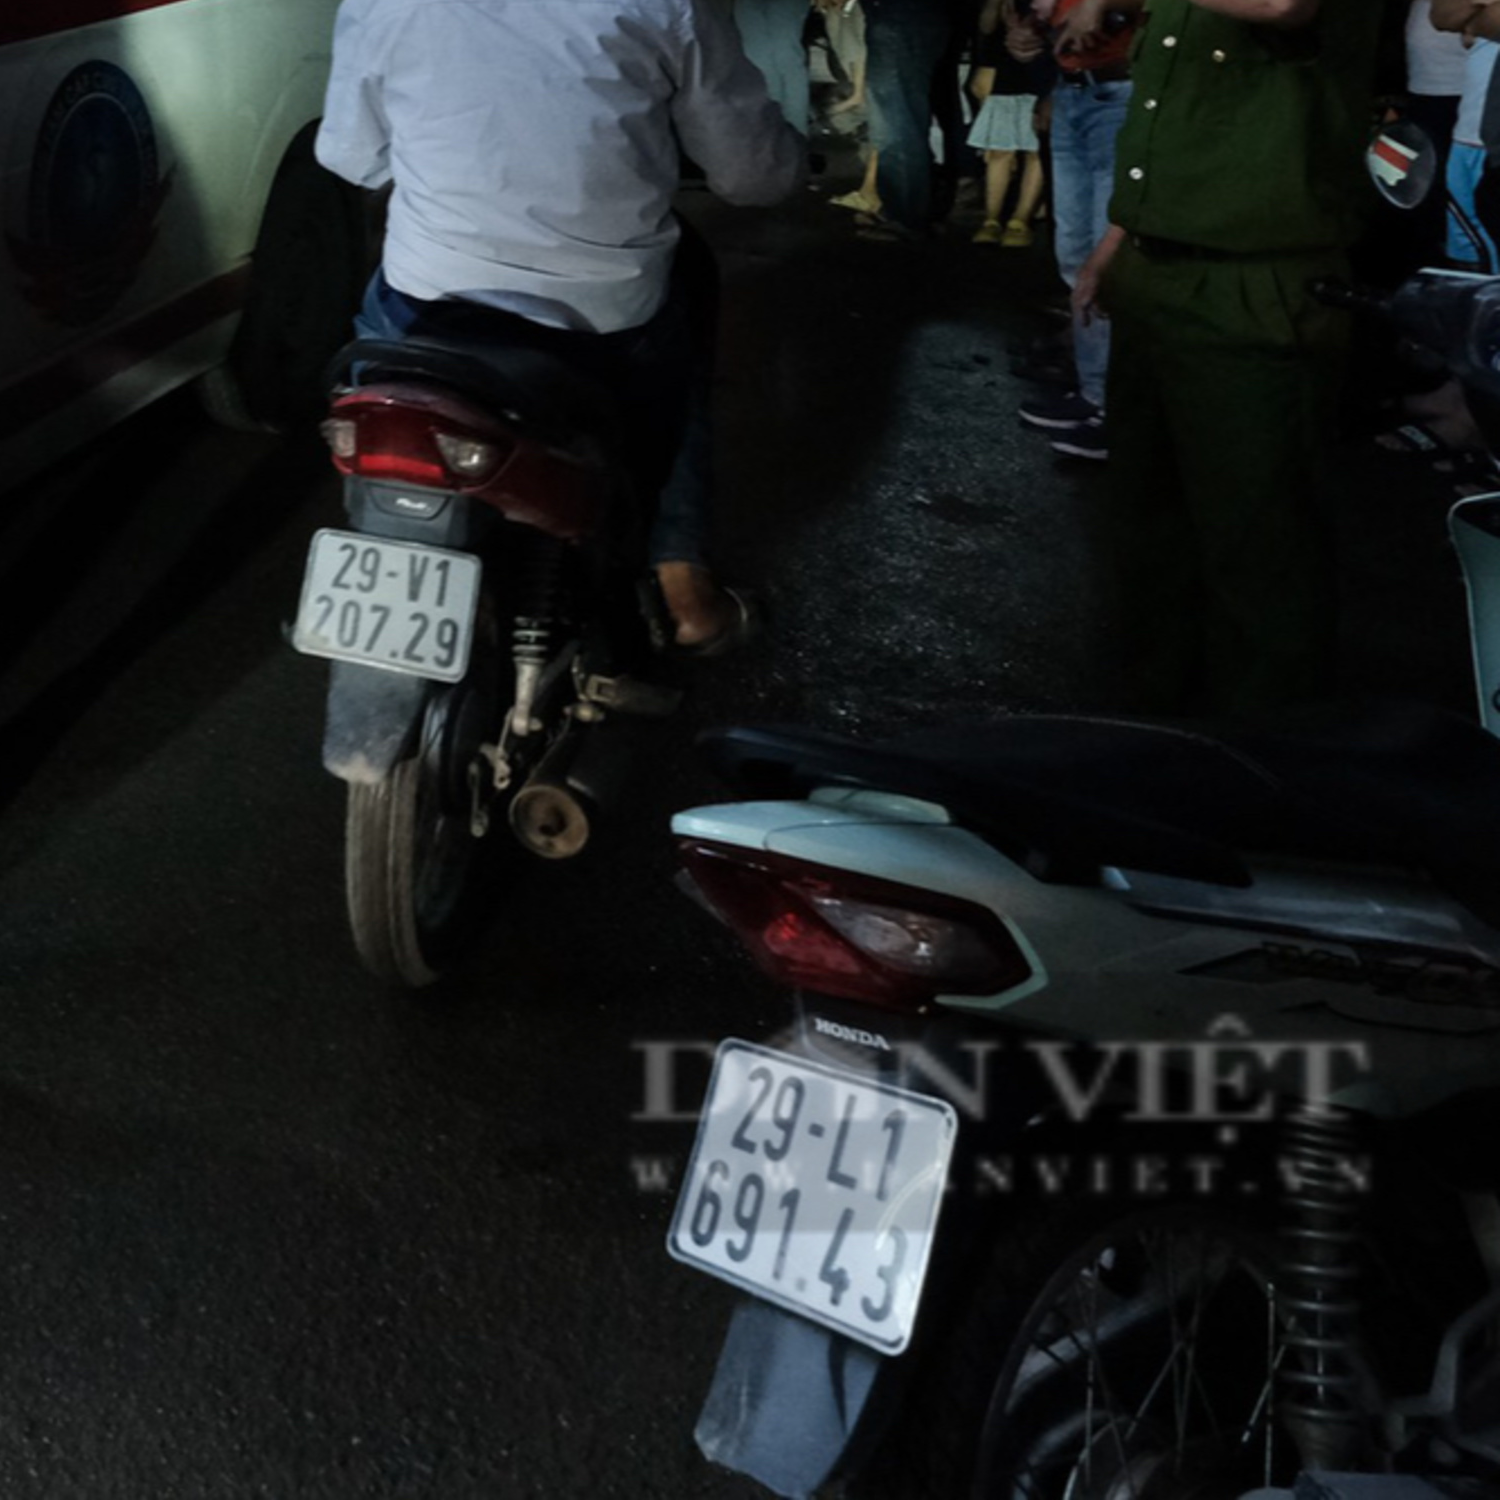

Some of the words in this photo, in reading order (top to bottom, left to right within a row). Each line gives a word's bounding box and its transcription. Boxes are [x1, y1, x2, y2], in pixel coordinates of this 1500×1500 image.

[331, 543, 451, 607] 29-V1
[311, 594, 459, 669] 207.29
[814, 1017, 891, 1052] HONDA
[731, 1066, 908, 1201] 29-L1
[689, 1160, 909, 1322] 691.43
